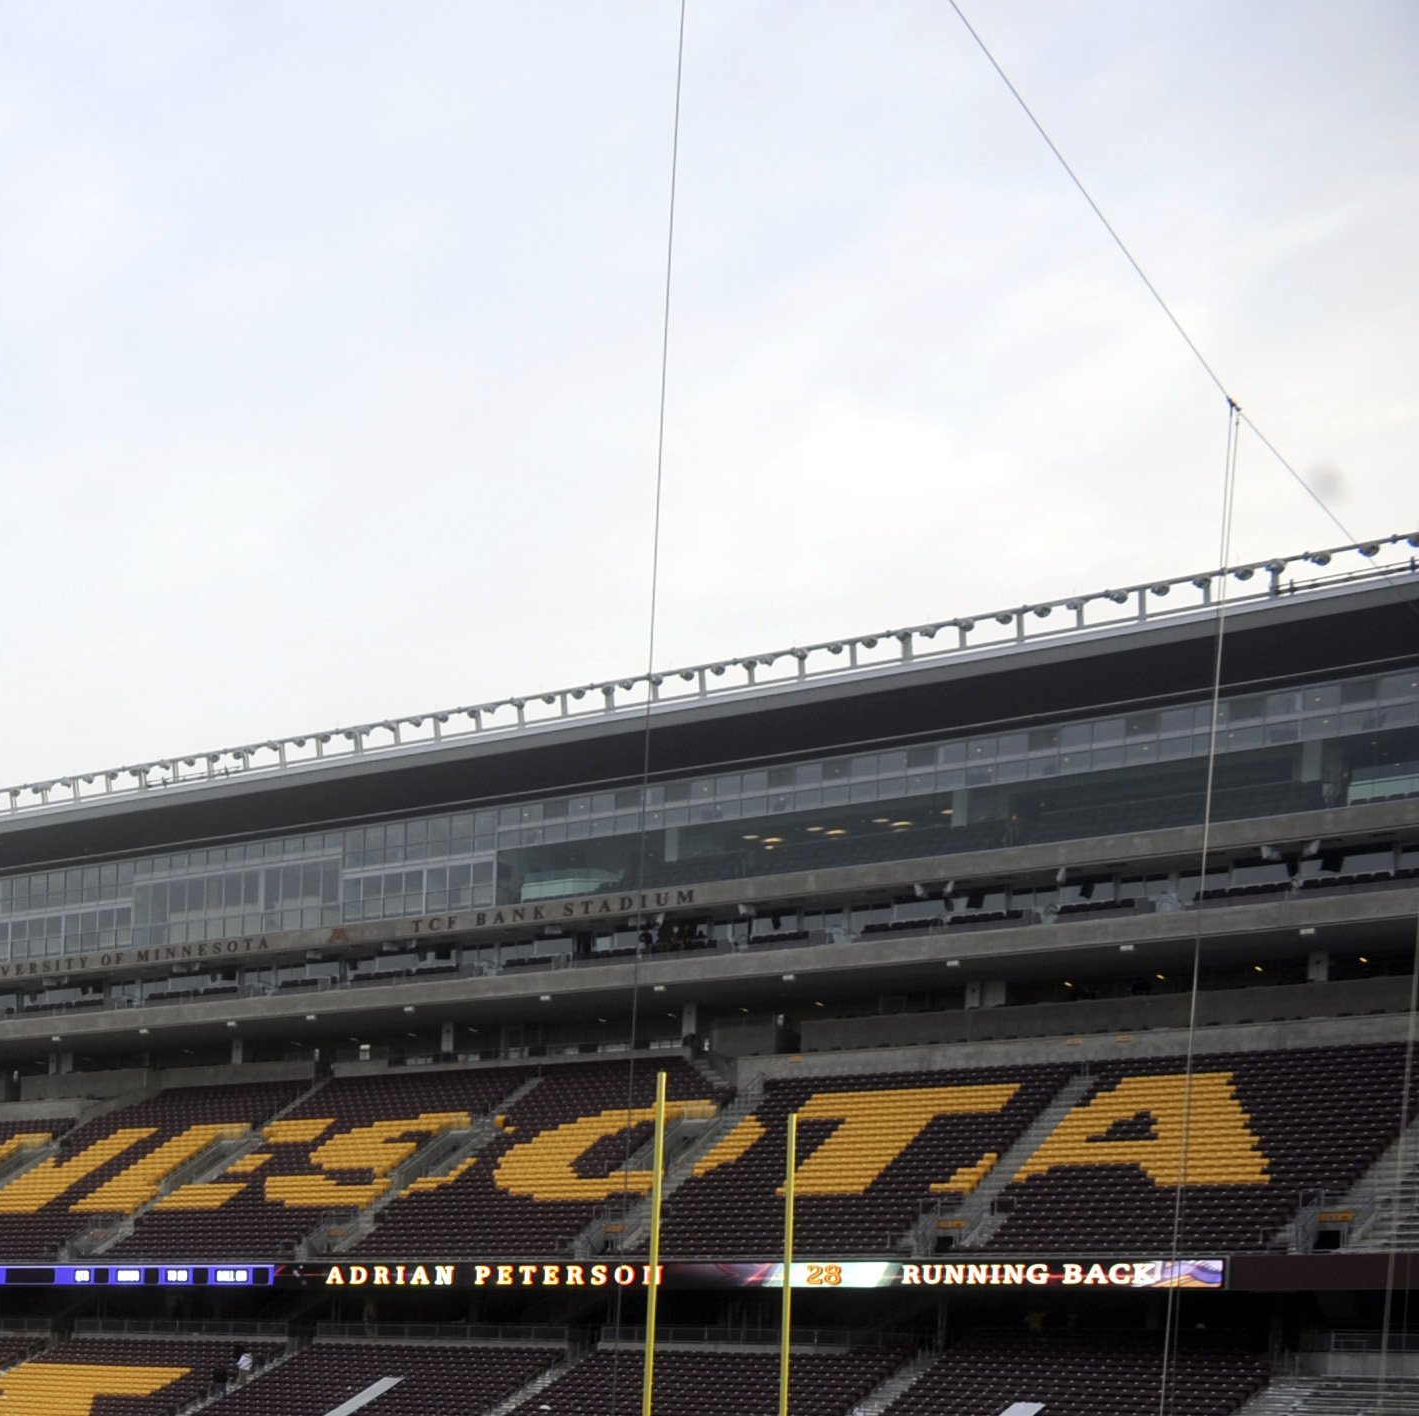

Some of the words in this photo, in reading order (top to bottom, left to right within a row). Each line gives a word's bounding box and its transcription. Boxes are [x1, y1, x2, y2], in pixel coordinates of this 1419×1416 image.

[412, 916, 457, 933] TCF
[475, 905, 546, 926] BANK
[564, 889, 695, 916] STADIUM
[101, 952, 124, 967] OF
[137, 937, 269, 963] MINNESOTA
[326, 1265, 454, 1285] ADRIAN
[474, 1265, 664, 1285] PETERSON
[806, 1265, 842, 1285] 28
[902, 1264, 1049, 1285] RUNNING
[1063, 1263, 1157, 1285] BACK
